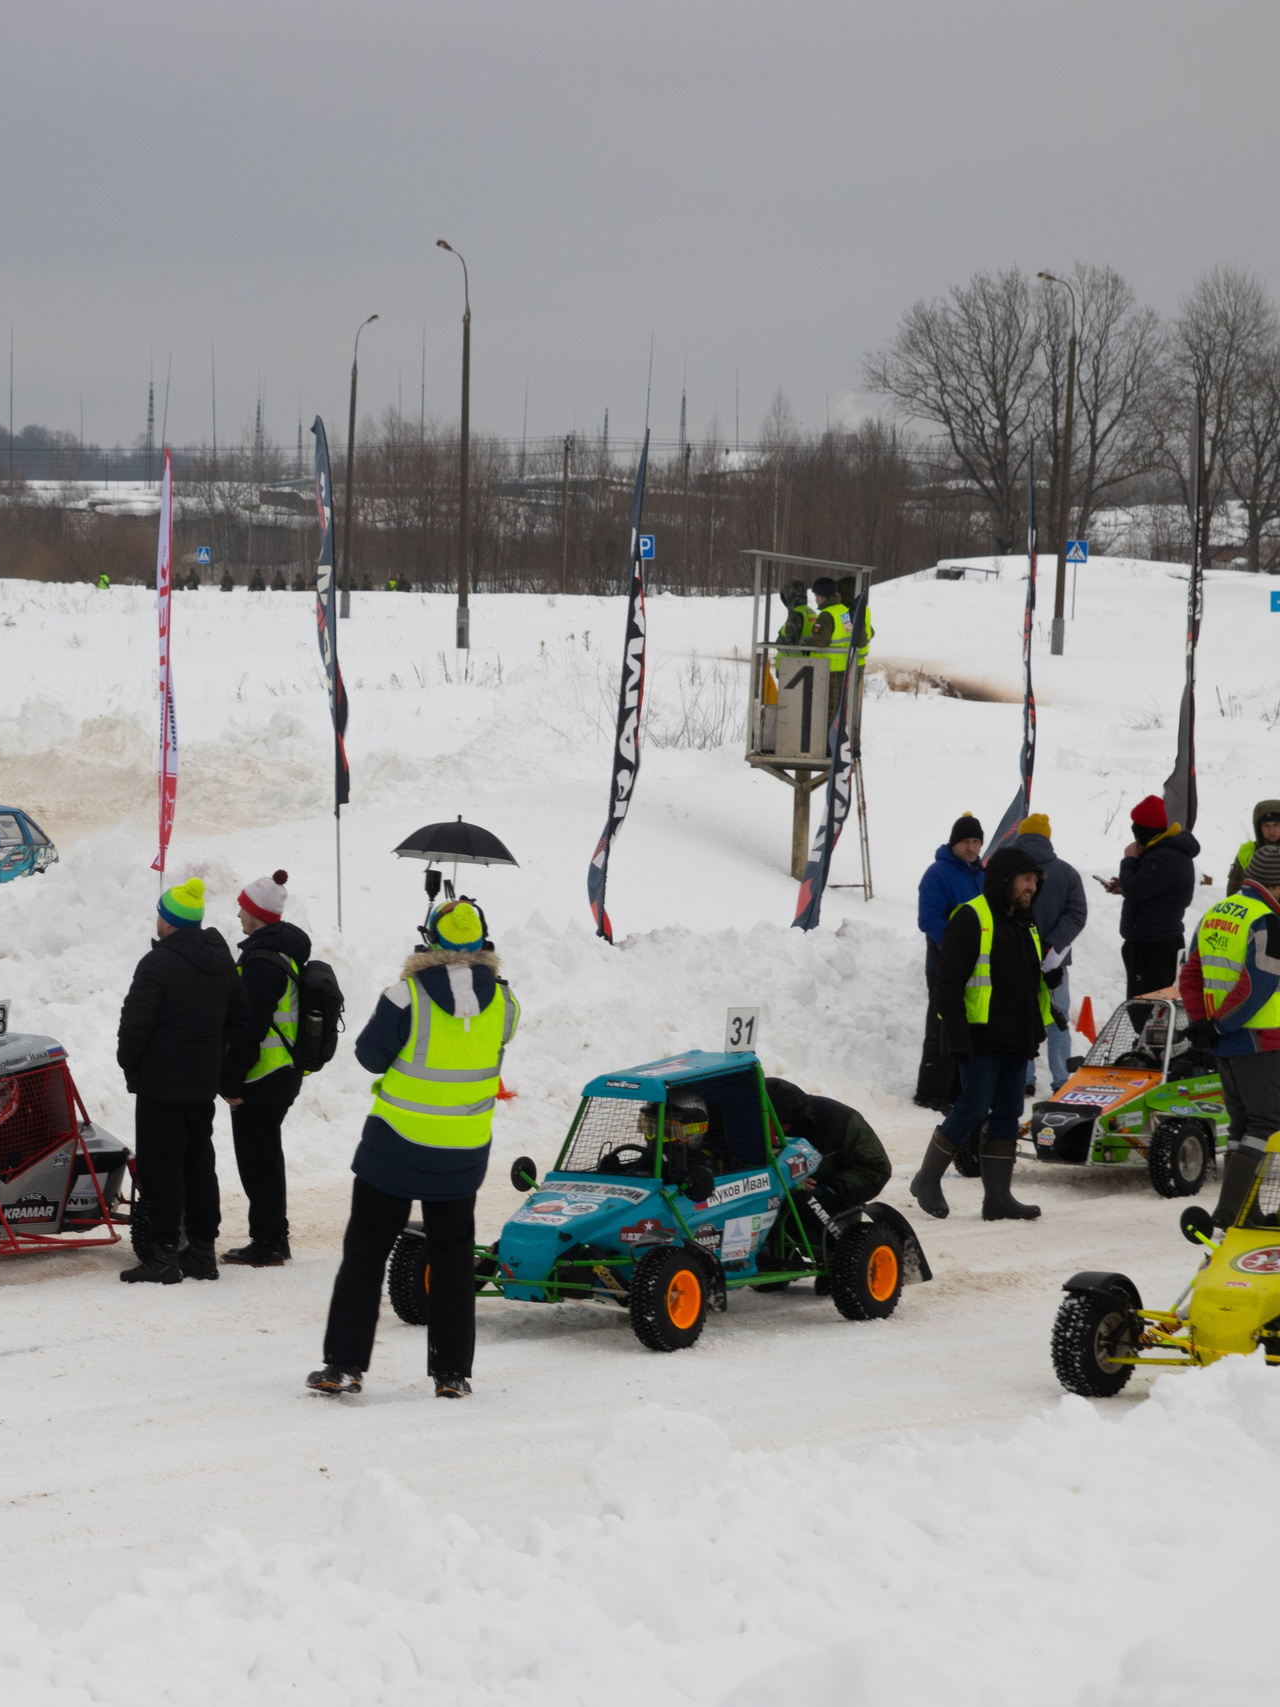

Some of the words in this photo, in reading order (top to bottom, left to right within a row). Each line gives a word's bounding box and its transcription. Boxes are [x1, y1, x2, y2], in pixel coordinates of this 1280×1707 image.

[784, 666, 814, 754] 1
[730, 1016, 754, 1046] 31
[1062, 1092, 1117, 1103] LIQUI
[742, 1176, 769, 1193] Иван
[4, 1206, 54, 1219] KRAMAR
